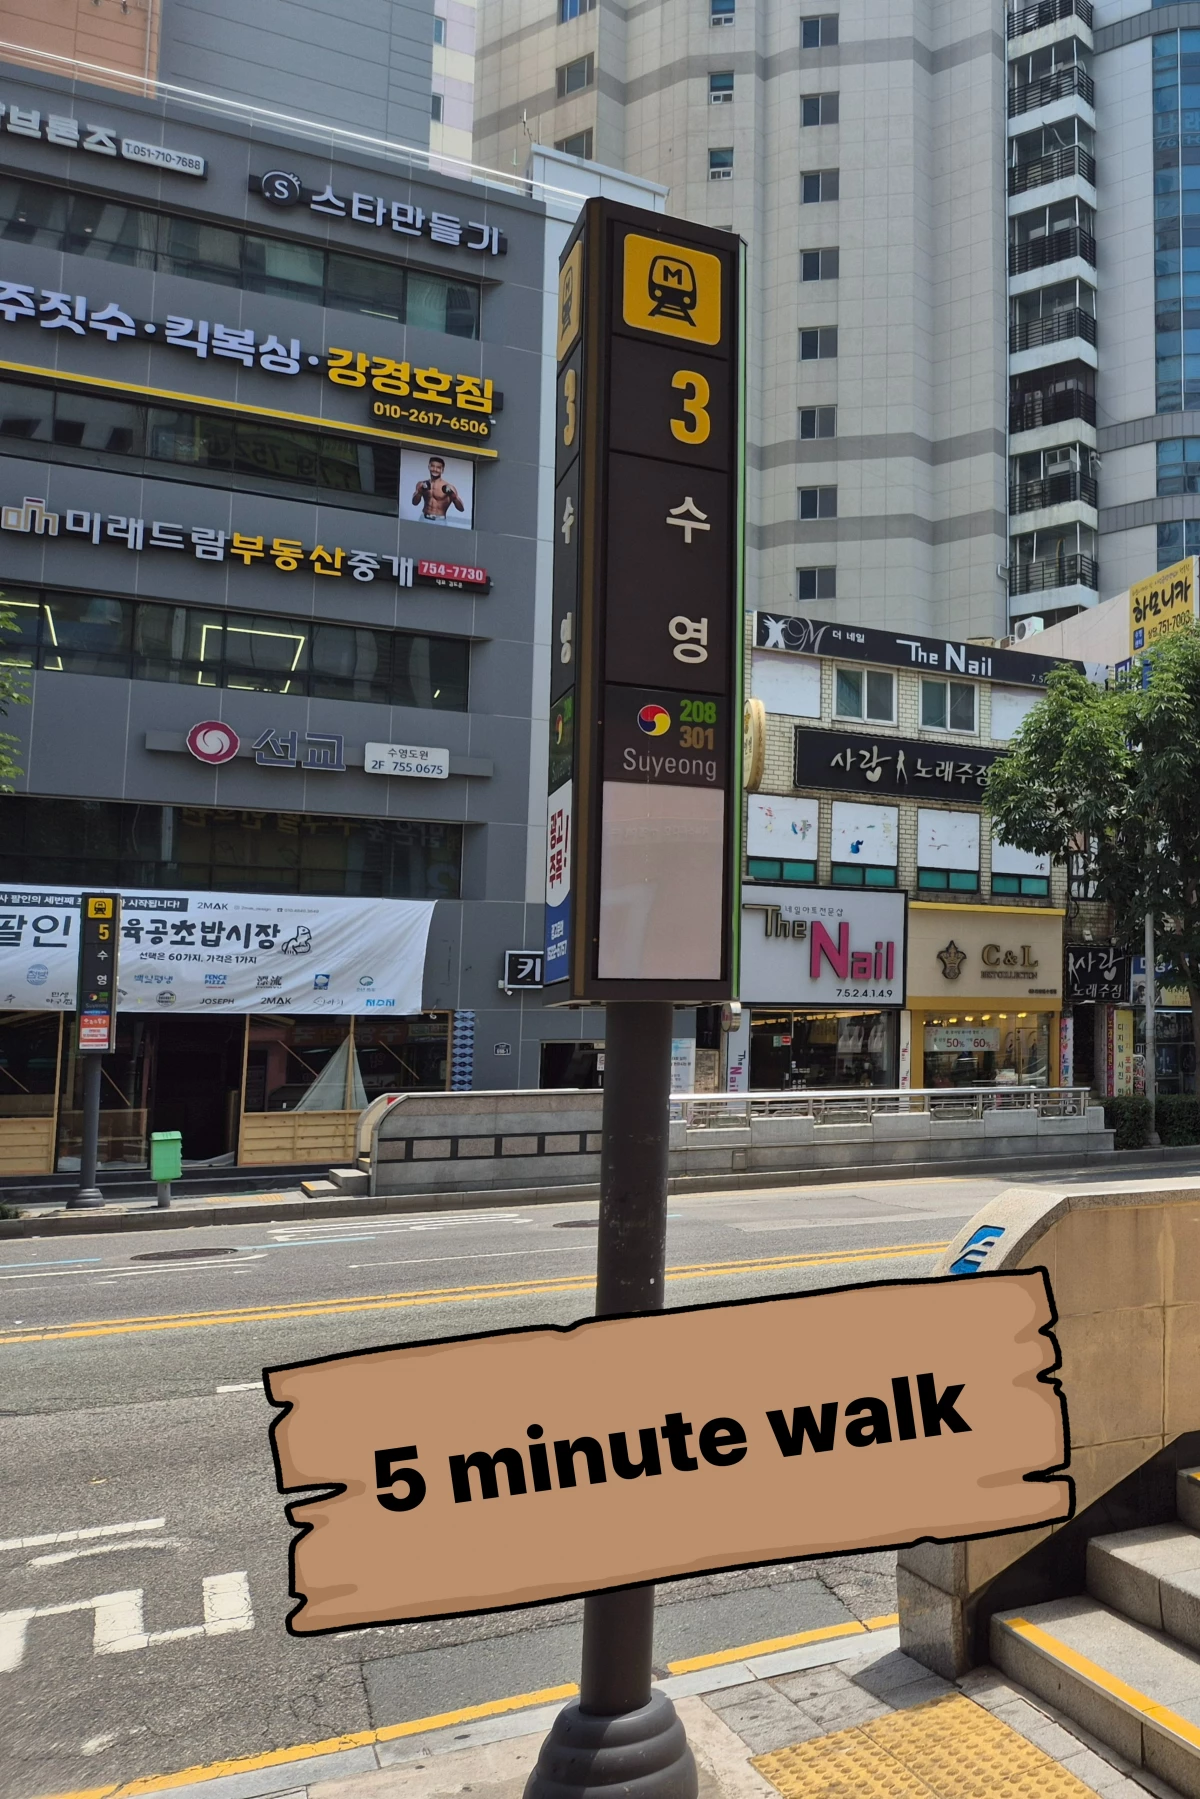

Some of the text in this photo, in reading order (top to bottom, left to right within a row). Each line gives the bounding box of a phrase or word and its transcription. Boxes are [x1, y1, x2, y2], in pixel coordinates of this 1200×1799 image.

[0, 103, 117, 157] 브론즈
[124, 140, 202, 171] T.051-710-7688
[310, 185, 501, 256] 스타만들기
[328, 347, 494, 414] 강경호짐
[373, 401, 489, 436] 010-2617-6506
[670, 369, 711, 445] 3
[421, 560, 485, 582] 754-7730
[1133, 576, 1191, 624] 하모니카
[832, 630, 865, 644] 더 네일
[896, 639, 992, 677] The Nail
[679, 699, 717, 724] 208
[679, 726, 714, 750] 301
[387, 747, 429, 760] 수영도원
[623, 747, 717, 781] Suyeong
[831, 745, 892, 782] 사랑
[371, 760, 443, 775] 2F 755.0675
[914, 758, 991, 787] 노래주점
[11, 895, 41, 905] 팔인의
[44, 896, 74, 906] 세번째
[128, 898, 180, 909] 시작됩니다!
[197, 902, 229, 911] 2MAK
[785, 905, 844, 917] 네일아트전문샵
[0, 914, 281, 950] 팔인 육공초밥시장
[98, 924, 109, 940] 5
[742, 903, 807, 939] The
[139, 952, 165, 961] 선택은
[206, 954, 232, 964] 가격은
[235, 956, 257, 965] 1가지
[810, 921, 895, 980] Nail
[981, 944, 1001, 967] C
[517, 957, 541, 981] 키
[1075, 947, 1125, 981] 사랑
[261, 997, 292, 1005] 2MAK
[836, 989, 893, 998] 7.5.2.4.1.4.9
[1073, 984, 1122, 999] 노래주점
[946, 1038, 965, 1048] 50%
[729, 1050, 746, 1092] The Nail
